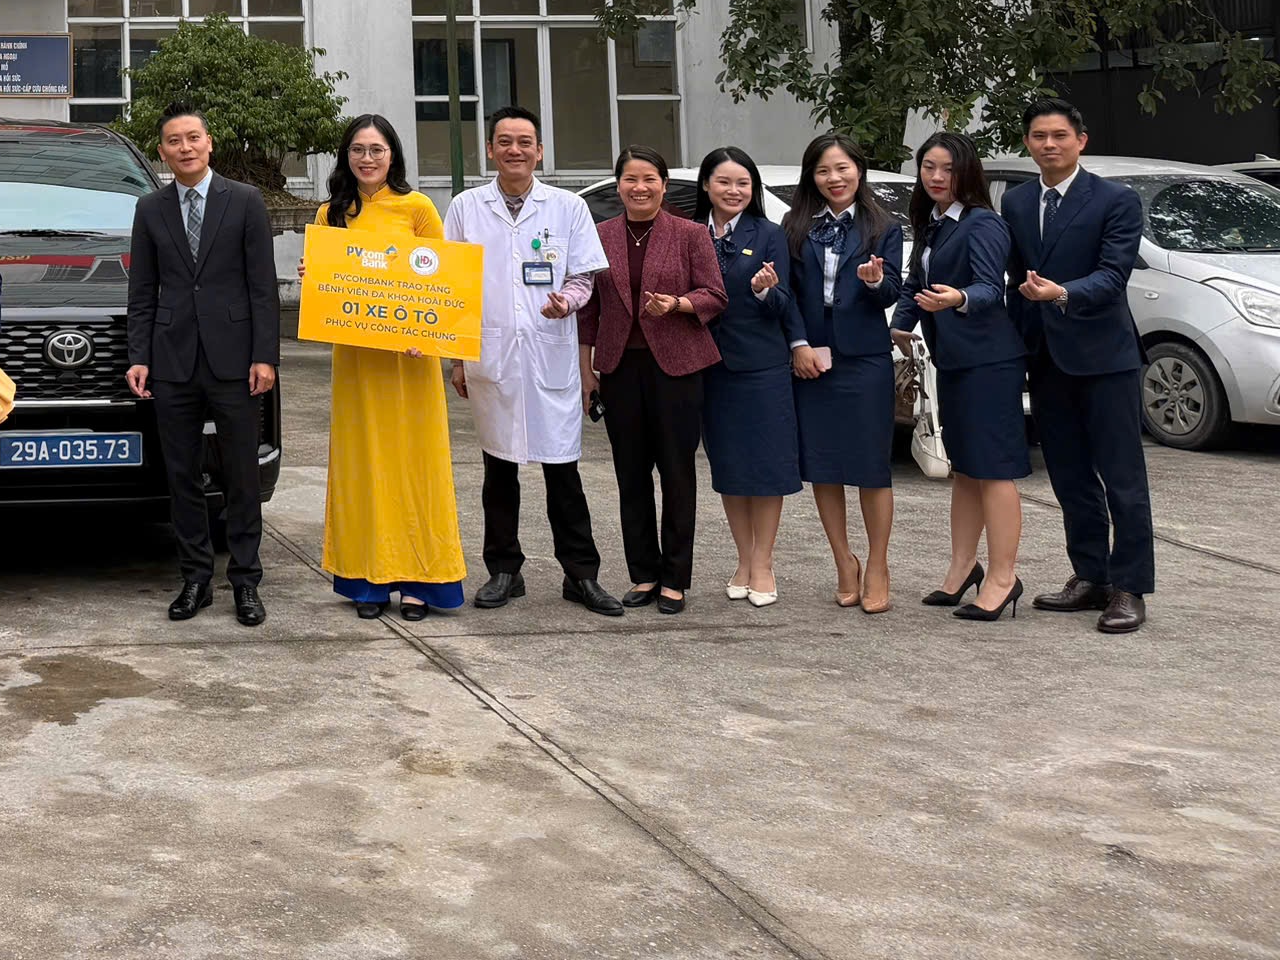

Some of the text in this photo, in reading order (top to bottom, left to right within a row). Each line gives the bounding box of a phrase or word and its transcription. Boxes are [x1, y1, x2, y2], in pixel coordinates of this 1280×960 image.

[362, 257, 388, 270] Bank
[333, 273, 395, 287] PVCOMBANK
[397, 281, 422, 291] TRAO
[371, 290, 385, 299] ĐA
[387, 291, 415, 303] KHOA
[418, 294, 441, 306] HOÀI
[444, 296, 465, 309] ĐỨC
[342, 301, 438, 325] 01 XE Ô TÔ
[325, 317, 456, 341] PHỤC VỤ CÔNG TÁC CHUNG
[11, 440, 129, 461] 29A-035.73
